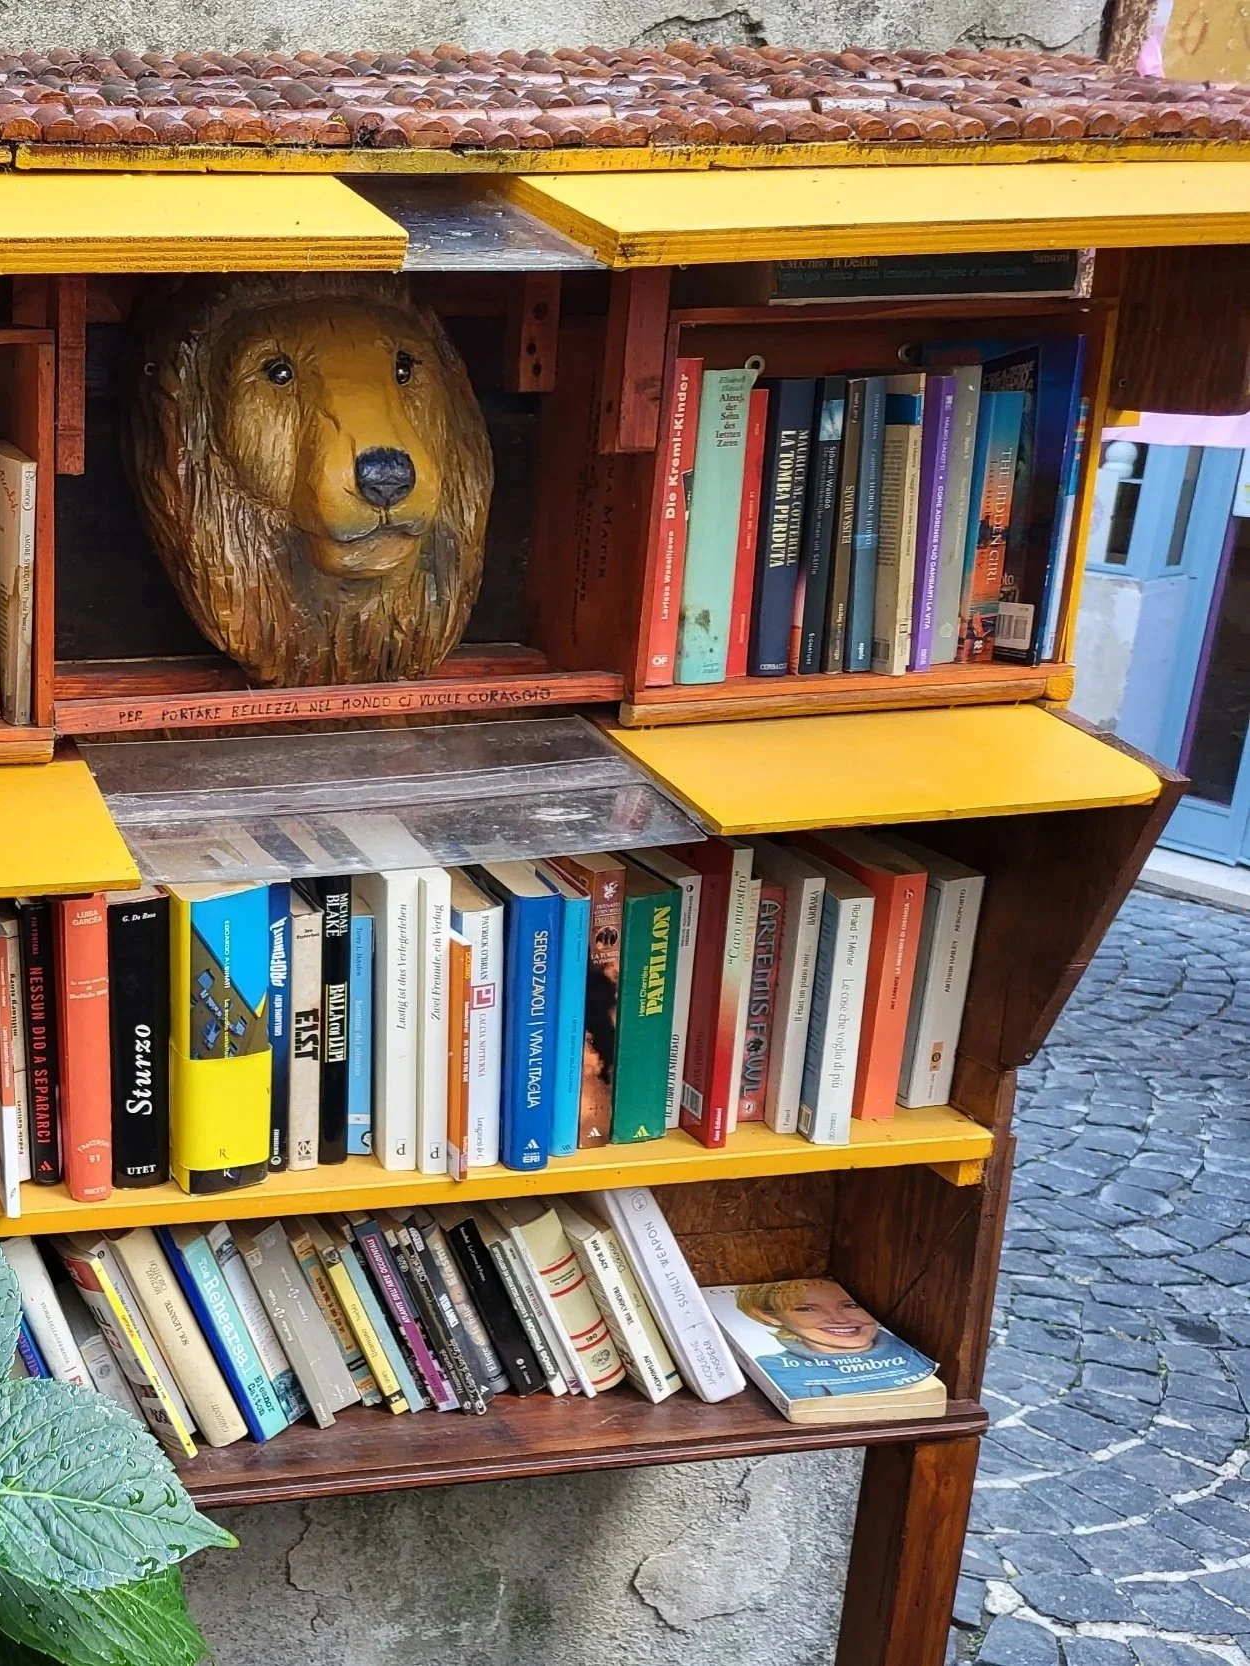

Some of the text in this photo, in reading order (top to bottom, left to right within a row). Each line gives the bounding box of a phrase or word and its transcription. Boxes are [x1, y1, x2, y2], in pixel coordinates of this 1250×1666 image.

[667, 371, 690, 487] Kreml-Kinder
[664, 491, 678, 520] Die
[767, 429, 796, 569] LA TOMBA PERDUTA
[785, 428, 809, 567] MAURICE M. COTTERELL
[983, 446, 1013, 585] THE HIDDEN GIRL
[839, 512, 854, 545] ELISSA
[659, 584, 671, 621] Larissa
[804, 631, 815, 666] SIGNATURE
[118, 709, 144, 725] PER
[161, 703, 222, 722] PORTARE
[231, 699, 300, 719] BELLEZZA
[309, 698, 333, 714] NEL
[342, 693, 392, 712] MONDO
[420, 687, 462, 707] VUOLE
[76, 909, 99, 919] LUISA
[323, 893, 341, 938] BLAKE
[335, 891, 349, 937] MICHAEL
[805, 888, 820, 927] BARBARA
[28, 927, 40, 956] FONTANA
[479, 914, 491, 949] PATRICK
[394, 902, 410, 1030] Lustig ist das Verlegerleben
[429, 903, 446, 1020] Zwei Freunde, ein Verlag
[477, 948, 490, 981] O'BRIAN
[531, 929, 548, 975] SERGIO
[644, 903, 672, 1017] PAPILLON
[27, 965, 47, 1021] NESSUN
[529, 975, 546, 1017] ZAVOLI
[740, 897, 782, 1098] ARTEMIS FOWL
[797, 967, 811, 989] piano
[797, 988, 807, 999] un
[826, 903, 862, 1090] Richard F. Miniter Le cose che voglio di più
[327, 983, 344, 1062] BALLA coi LUPI
[476, 1012, 487, 1038] CACCIA
[792, 998, 805, 1016] était
[792, 1015, 803, 1023] Il
[30, 1025, 48, 1051] DIO
[527, 1027, 544, 1057] VIVA
[32, 1054, 48, 1065] A
[126, 1023, 153, 1117] Sturzo
[475, 1039, 487, 1078] NOTTURNA
[31, 1068, 54, 1145] SEPARARCI
[827, 1111, 837, 1141] CORBACCIO
[473, 1116, 485, 1147] Longanesi
[127, 1164, 156, 1176] UTET
[219, 1148, 230, 1160] R
[523, 1155, 541, 1164] ERI
[431, 1238, 459, 1288] Erasme
[642, 1219, 673, 1269] WEAPON
[147, 1257, 170, 1293] CRICHTON
[364, 1236, 412, 1325] ATLANTE DELL'ARTE OCCIDENTALE
[663, 1268, 690, 1309] SUNLIT
[162, 1298, 191, 1347] SOL LEVANTE
[195, 1256, 261, 1377] The Rehearsal
[436, 1292, 460, 1329] VERI AMICI
[589, 1237, 666, 1394] BOB BLACK FRIENDLY FIRE AUTONOMEDIA
[523, 1316, 557, 1377] ADIÓS PRISIÓN
[688, 1337, 717, 1389] JACQUELINE
[700, 1337, 727, 1381] WINSPEAR
[782, 1355, 863, 1368] Io e la mia
[839, 1355, 907, 1375] ombra
[244, 1381, 268, 1417] Catton
[251, 1374, 278, 1414] Eleanor
